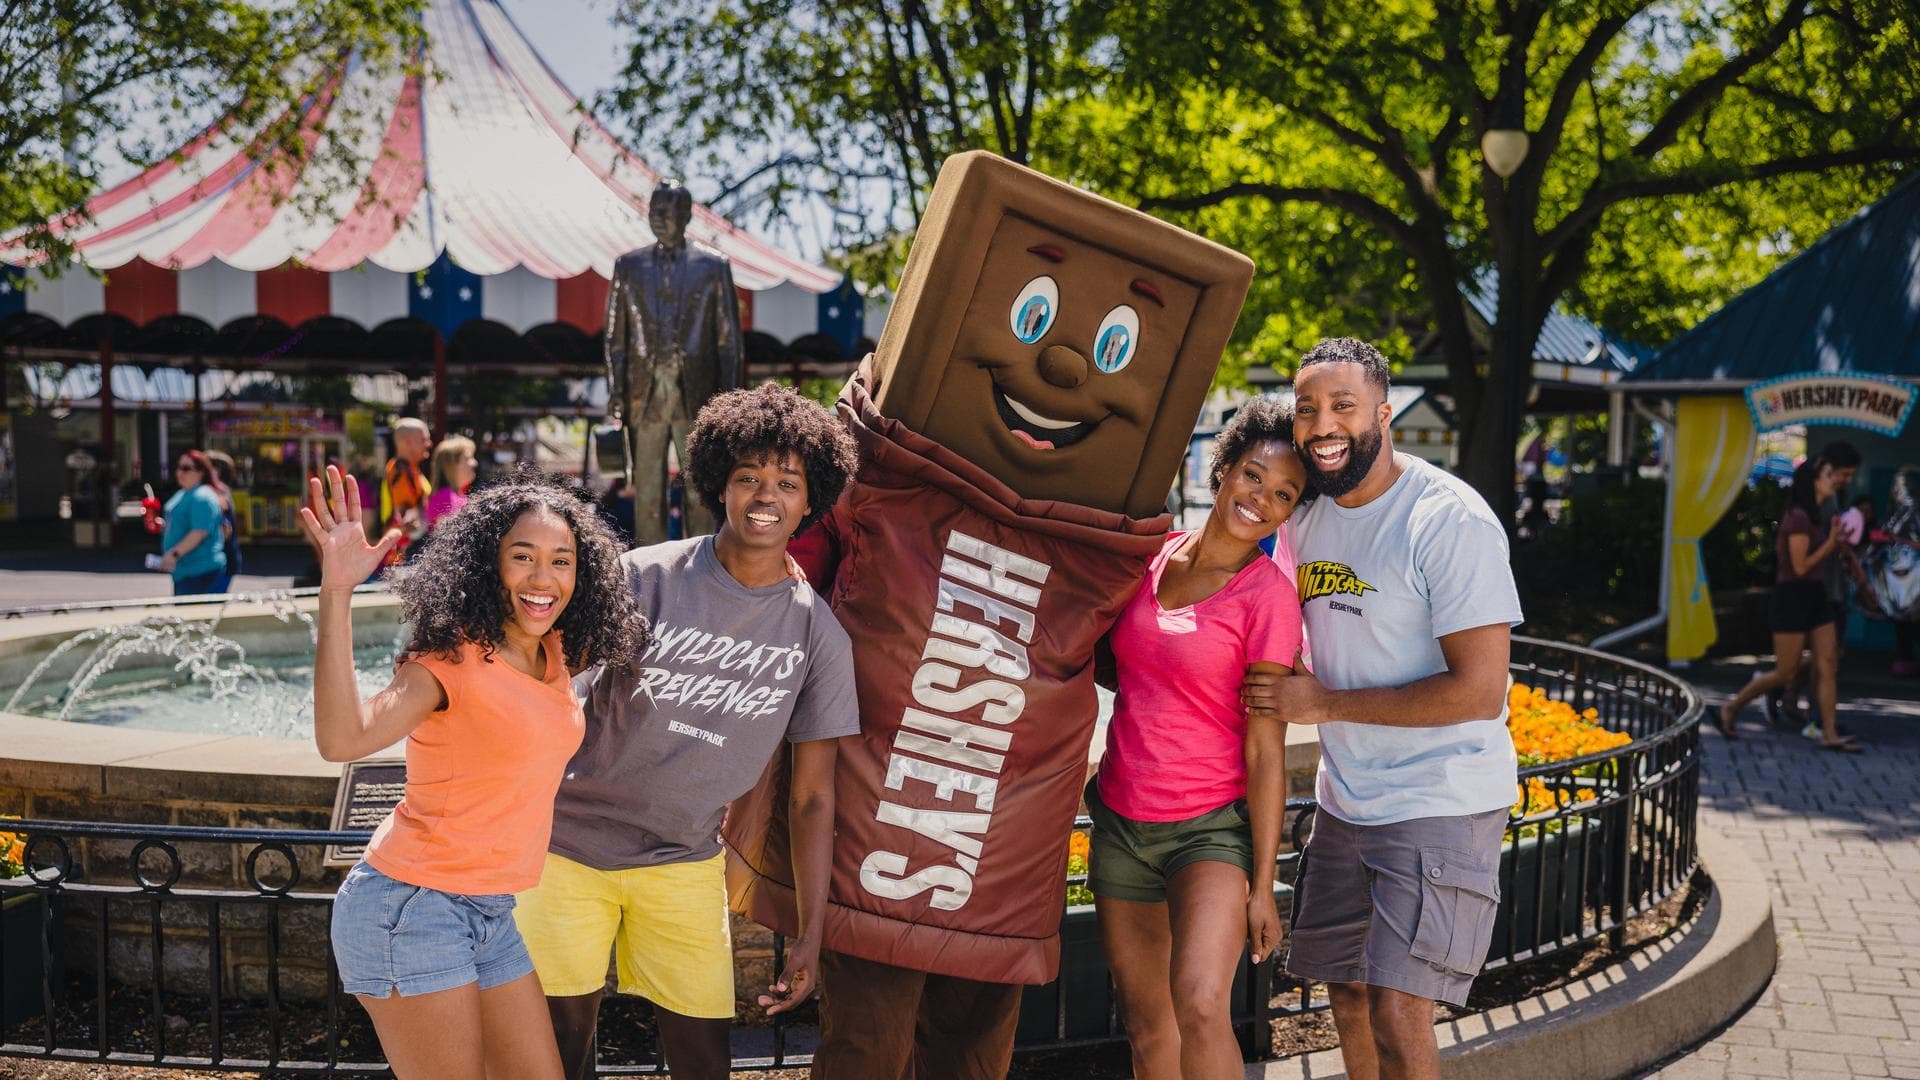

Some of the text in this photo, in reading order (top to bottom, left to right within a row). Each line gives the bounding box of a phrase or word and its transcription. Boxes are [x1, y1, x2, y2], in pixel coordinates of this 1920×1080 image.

[1781, 384, 1904, 419] HERSHEYPARK
[1296, 563, 1379, 608] WILDCAT
[1313, 561, 1357, 578] THE
[1329, 600, 1363, 617] HERSHEYPARK
[640, 619, 805, 680] WILDCAT'S
[630, 667, 791, 721] REVENGE
[668, 719, 726, 748] HERSHEYPARK
[859, 529, 1052, 912] HERSHEY'S
